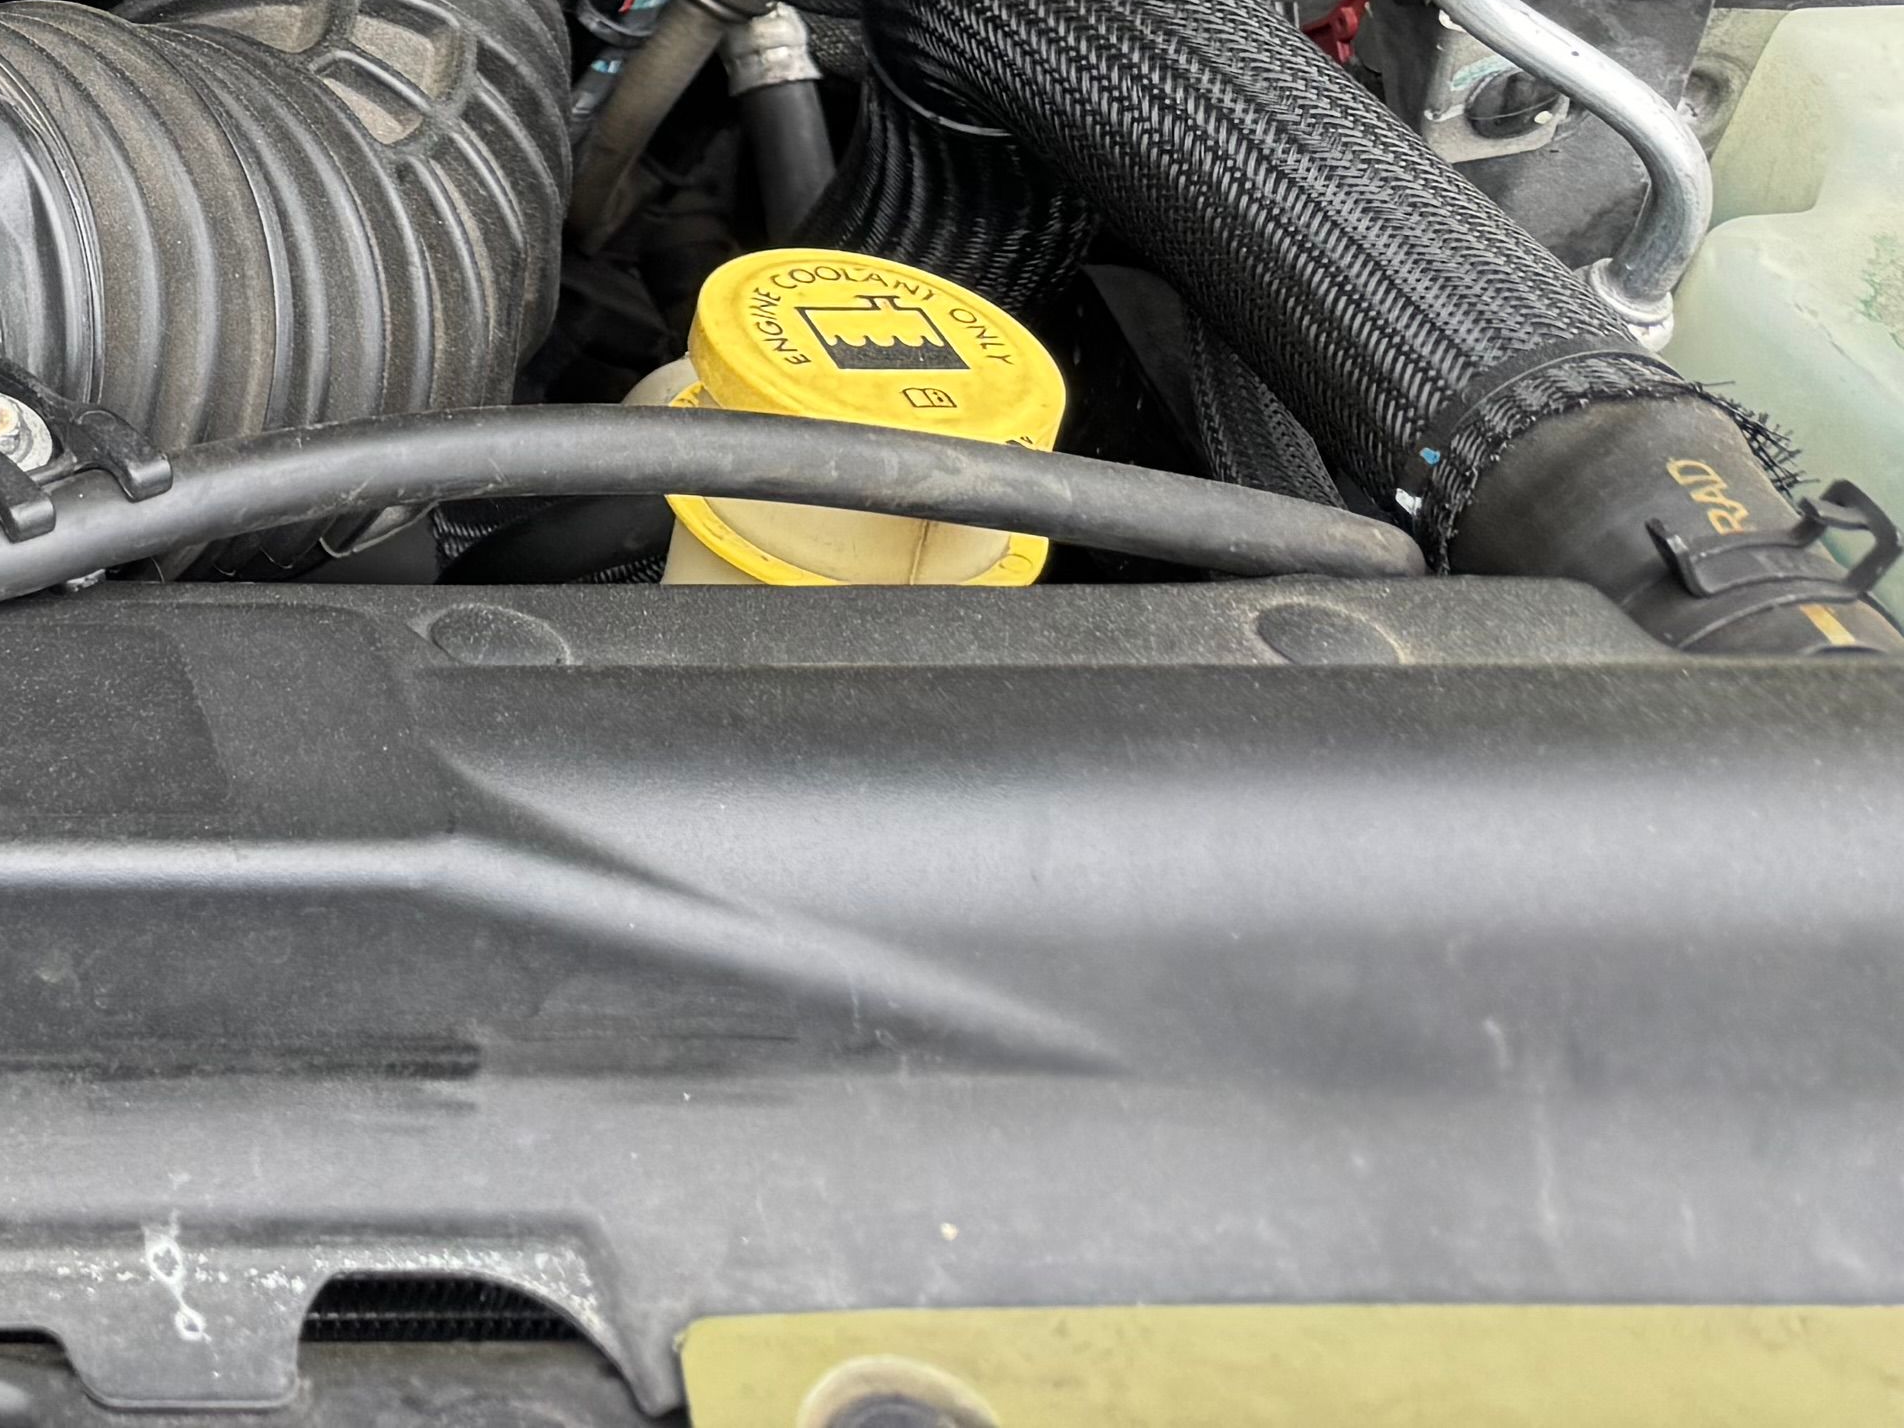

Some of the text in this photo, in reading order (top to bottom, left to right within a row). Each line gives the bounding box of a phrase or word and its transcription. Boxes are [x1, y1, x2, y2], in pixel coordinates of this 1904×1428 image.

[748, 264, 1015, 367] ENGINE COOLANT ONLY
[1665, 457, 1749, 536] RAD
